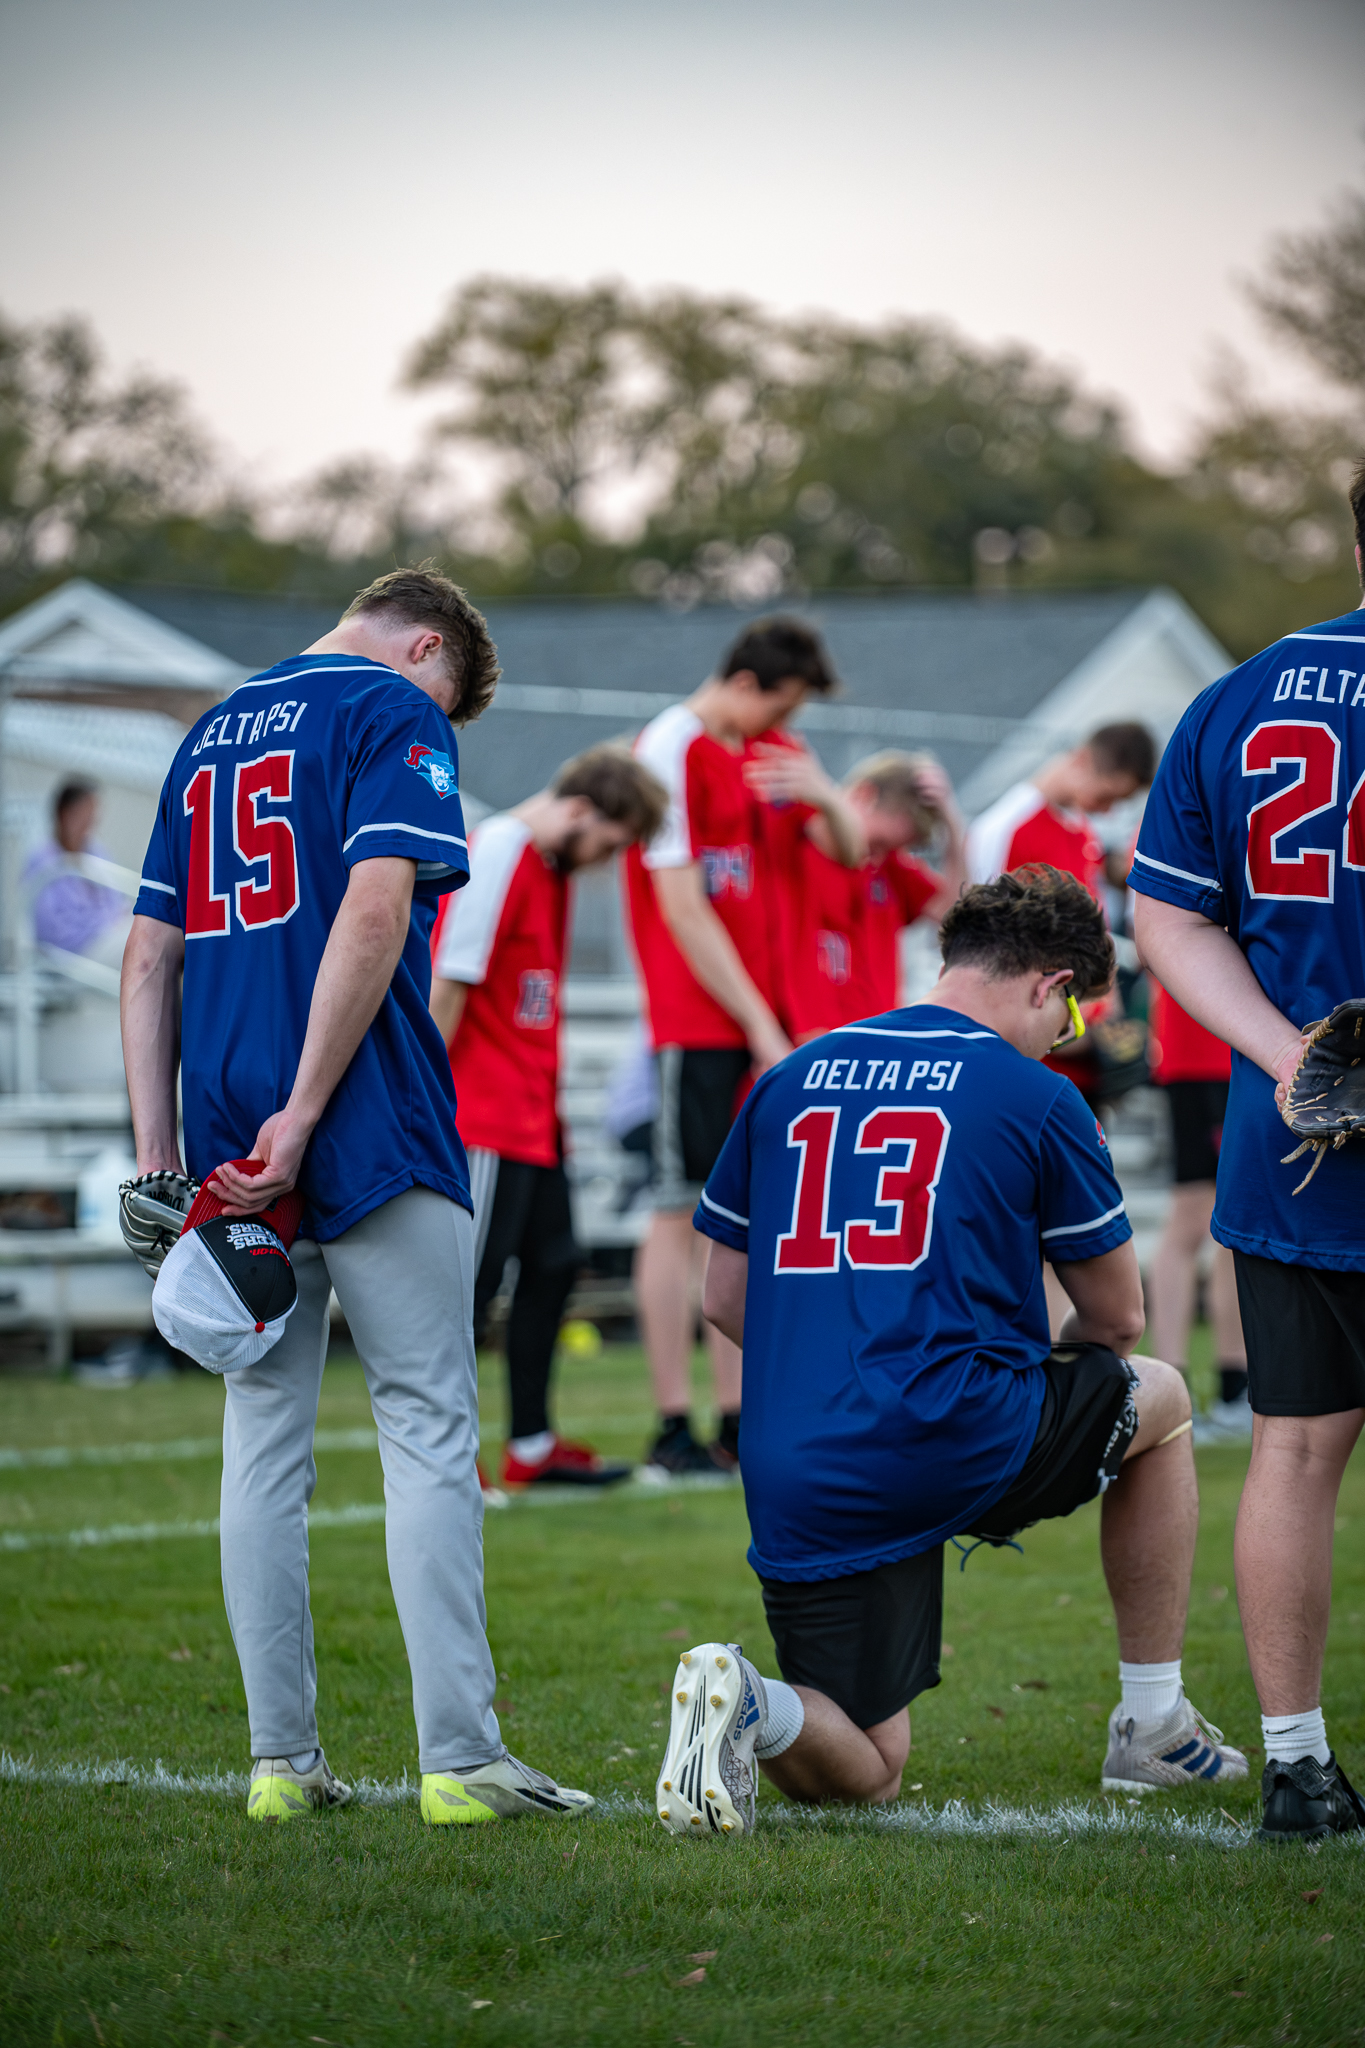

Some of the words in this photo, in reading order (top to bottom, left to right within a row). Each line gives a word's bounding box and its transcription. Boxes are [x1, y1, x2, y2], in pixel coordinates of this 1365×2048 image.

[183, 749, 300, 940] 15
[1242, 719, 1365, 904] 2
[802, 1059, 902, 1091] DELTA
[905, 1060, 964, 1092] PSI
[774, 1106, 952, 1275] 13
[733, 1681, 753, 1741] didas
